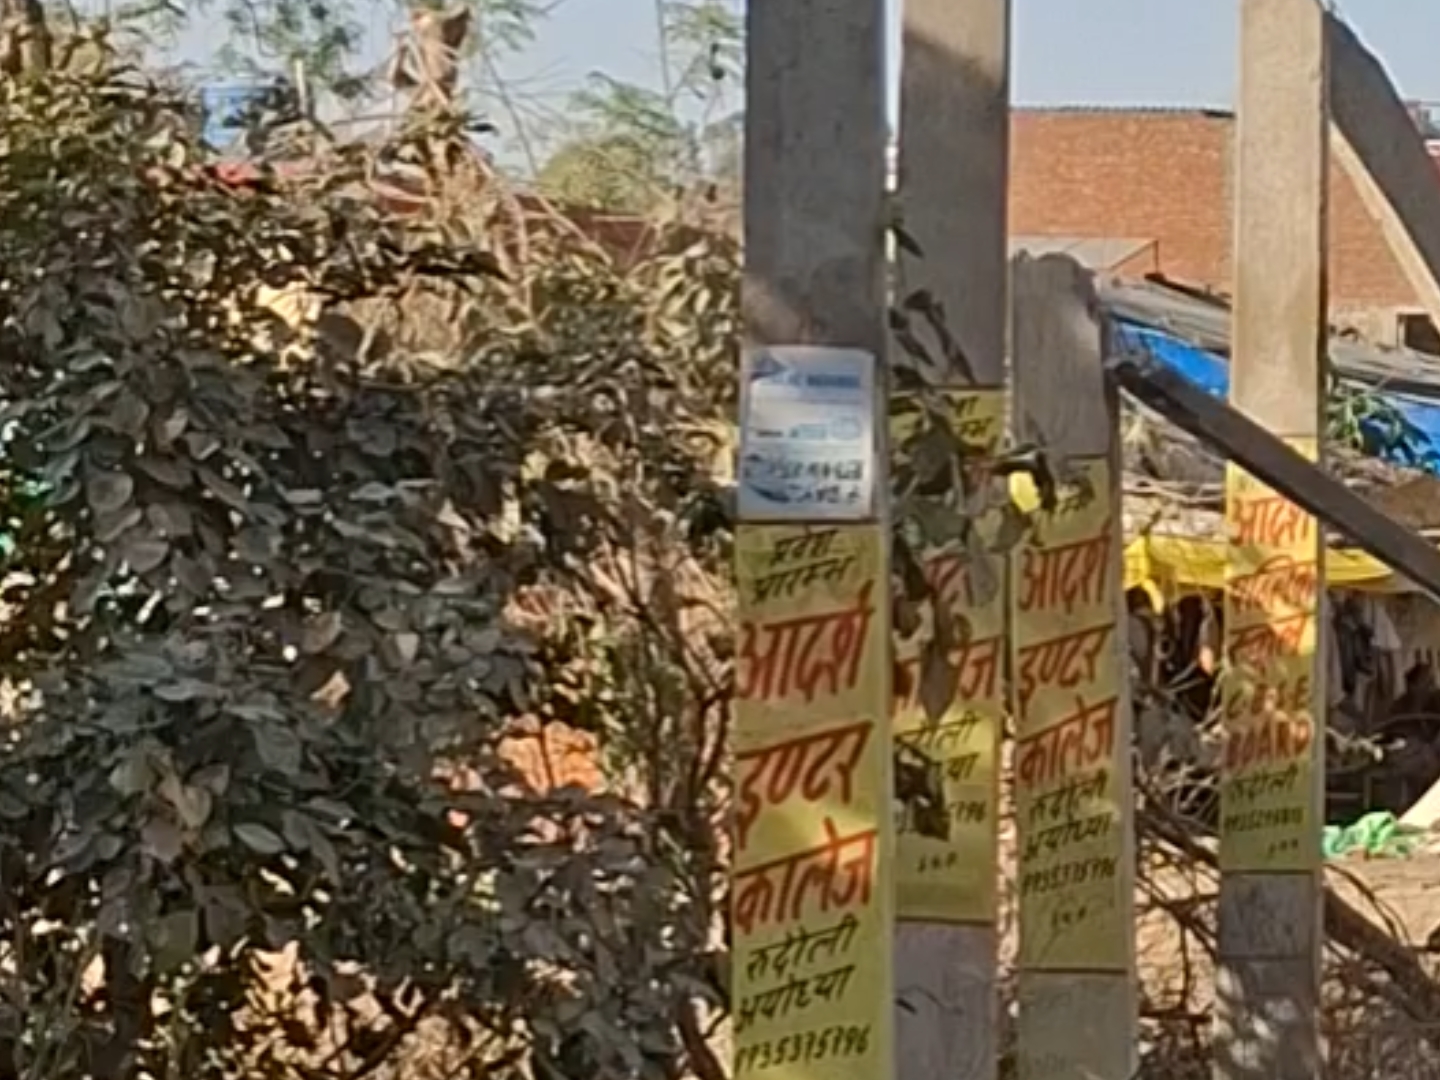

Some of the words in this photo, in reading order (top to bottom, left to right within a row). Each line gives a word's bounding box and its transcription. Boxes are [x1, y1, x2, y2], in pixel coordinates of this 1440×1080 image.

[1018, 515, 1112, 615] आदर्श
[738, 579, 876, 702] आदर्श
[1018, 623, 1115, 718] इण्टर
[735, 721, 874, 851] इण्टर
[1017, 694, 1118, 788] कालेज
[733, 816, 878, 935] कालेज
